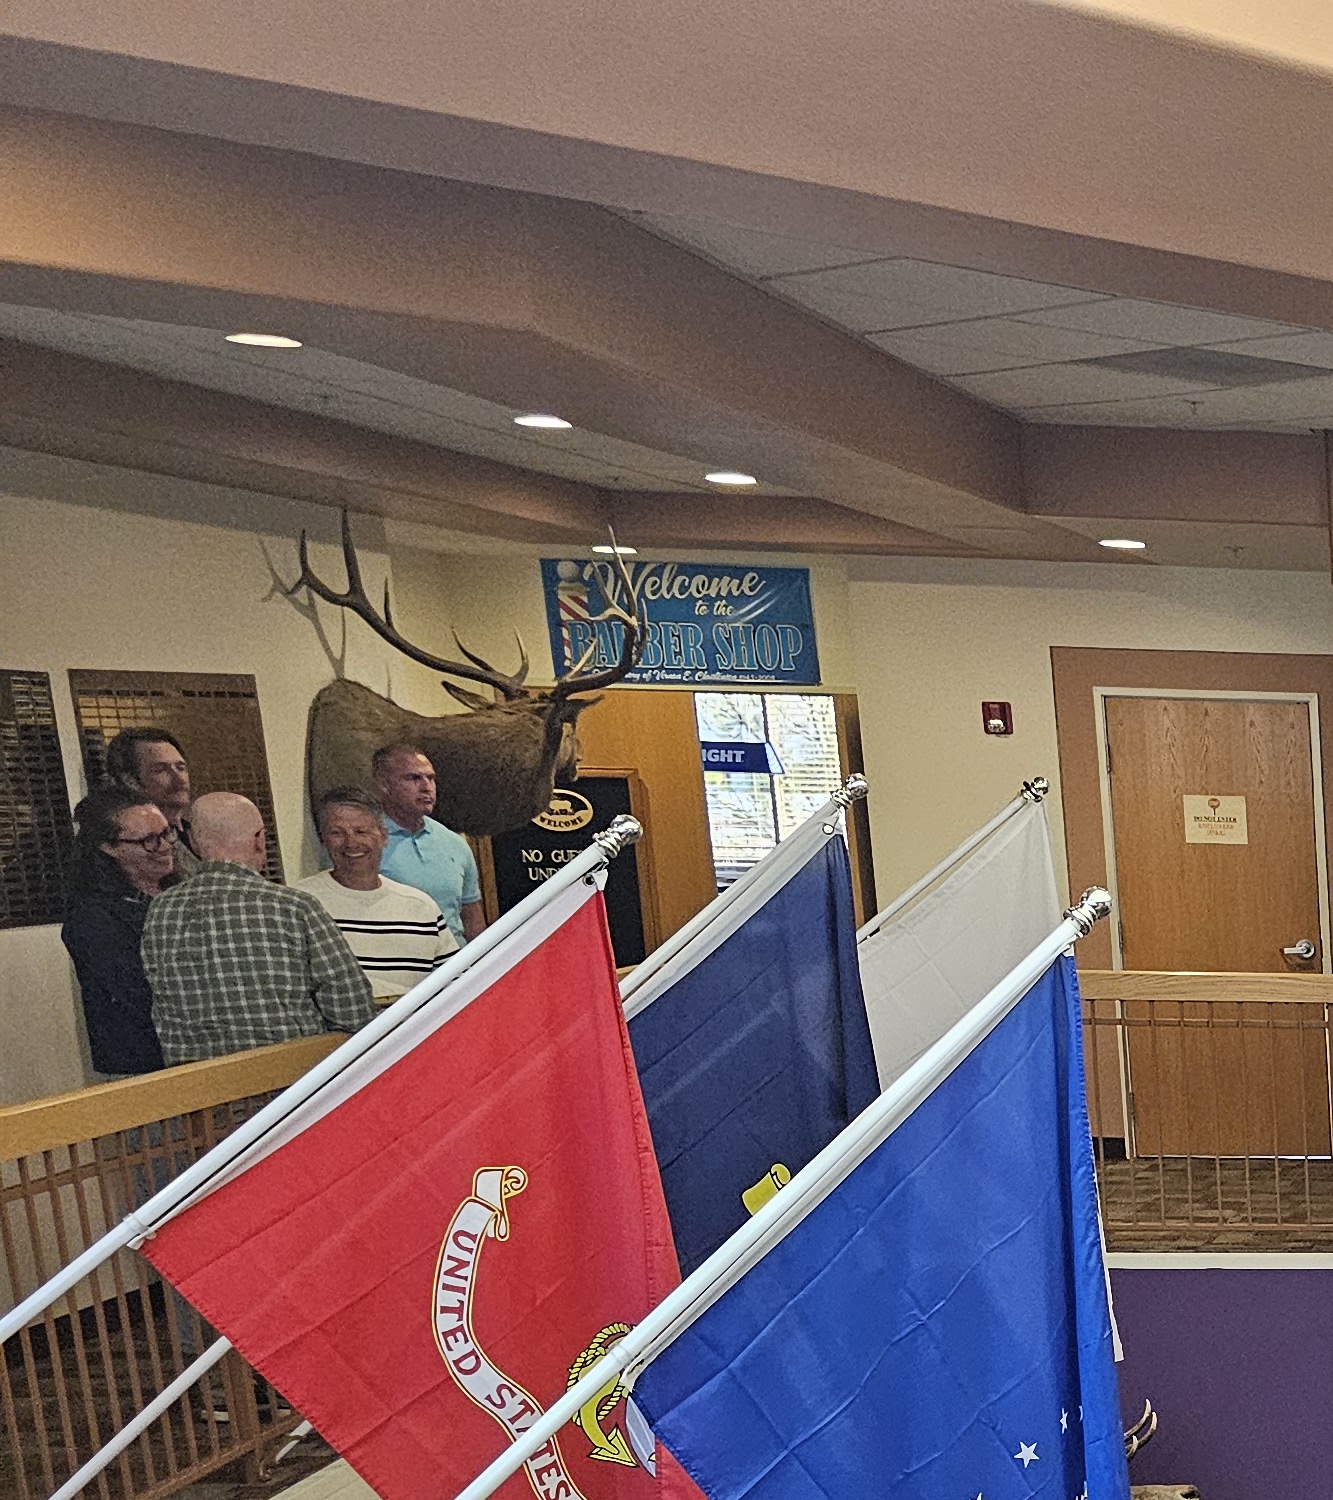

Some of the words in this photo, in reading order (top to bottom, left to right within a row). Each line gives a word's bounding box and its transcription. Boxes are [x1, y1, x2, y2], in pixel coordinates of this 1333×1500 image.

[583, 561, 766, 600] Welcome
[694, 600, 709, 616] to
[713, 600, 735, 617] the
[568, 620, 706, 670] BABER
[713, 621, 803, 670] SHOP
[539, 816, 584, 828] WELCOME
[521, 850, 543, 863] NO
[551, 850, 582, 863] GUE
[528, 867, 560, 881] UND
[438, 1228, 482, 1377] UNITED
